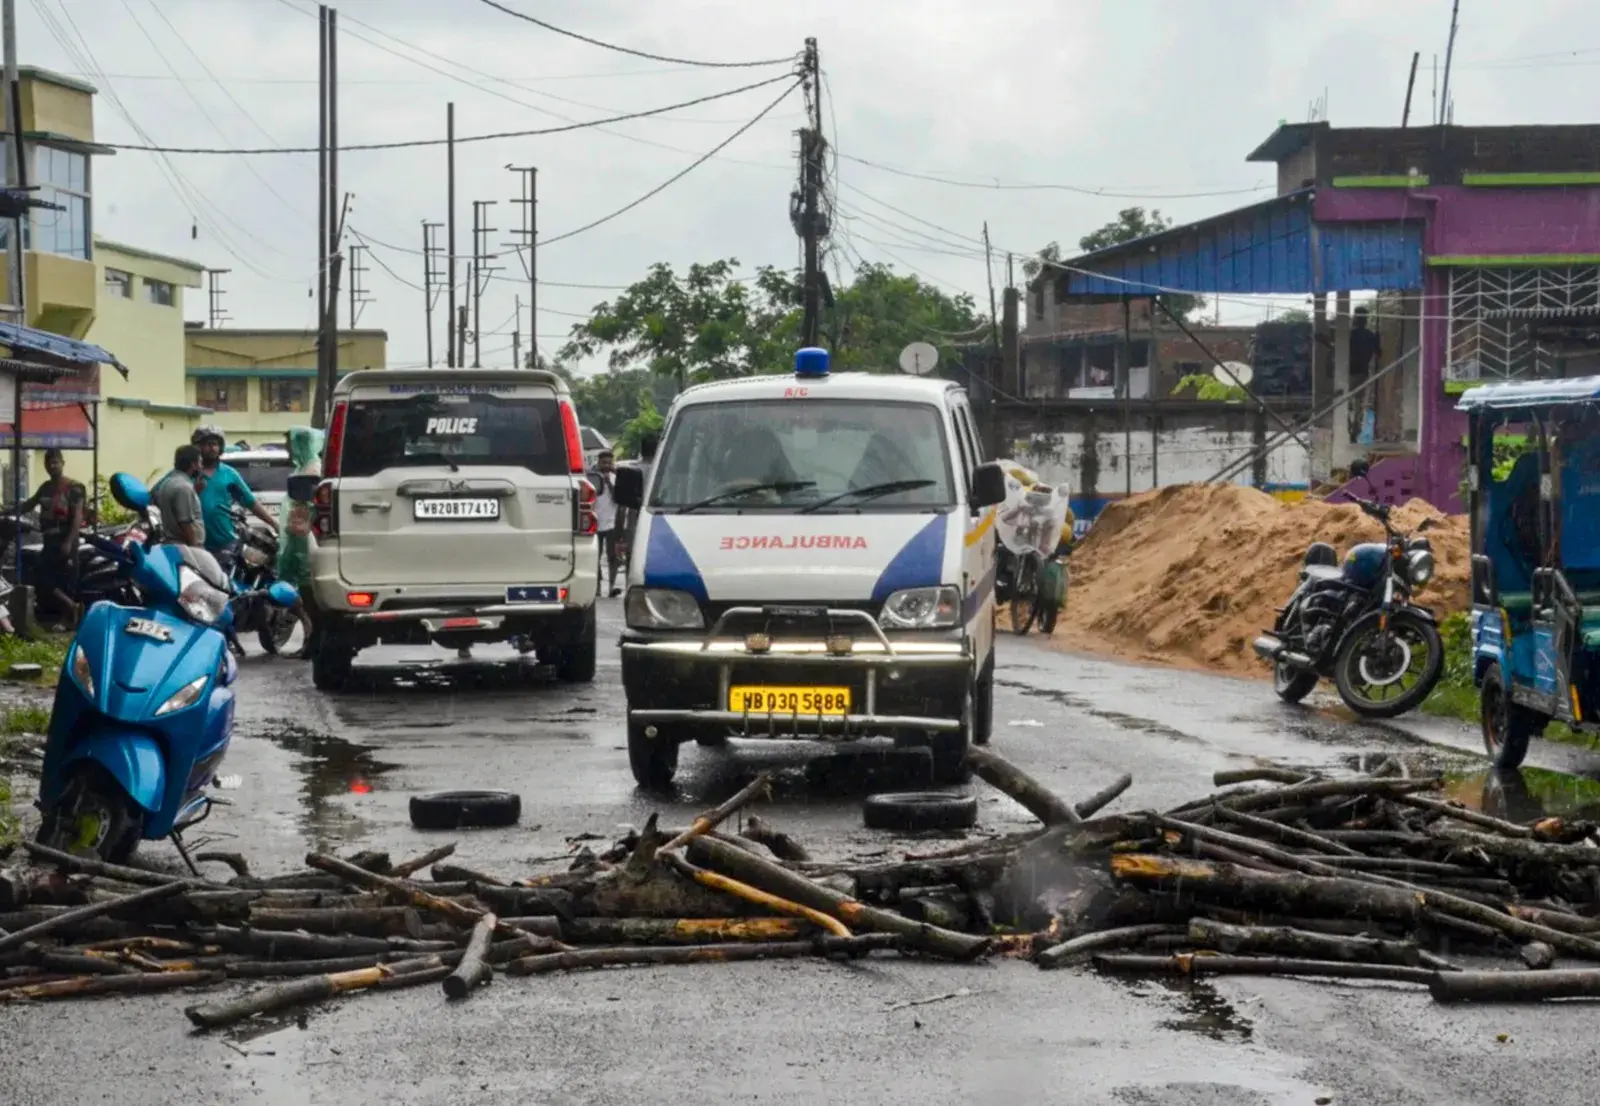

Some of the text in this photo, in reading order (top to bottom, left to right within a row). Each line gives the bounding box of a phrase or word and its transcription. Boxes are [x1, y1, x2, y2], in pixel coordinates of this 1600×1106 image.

[784, 387, 808, 398] A/C
[425, 417, 478, 434] POLICE
[803, 693, 845, 710] 5888
